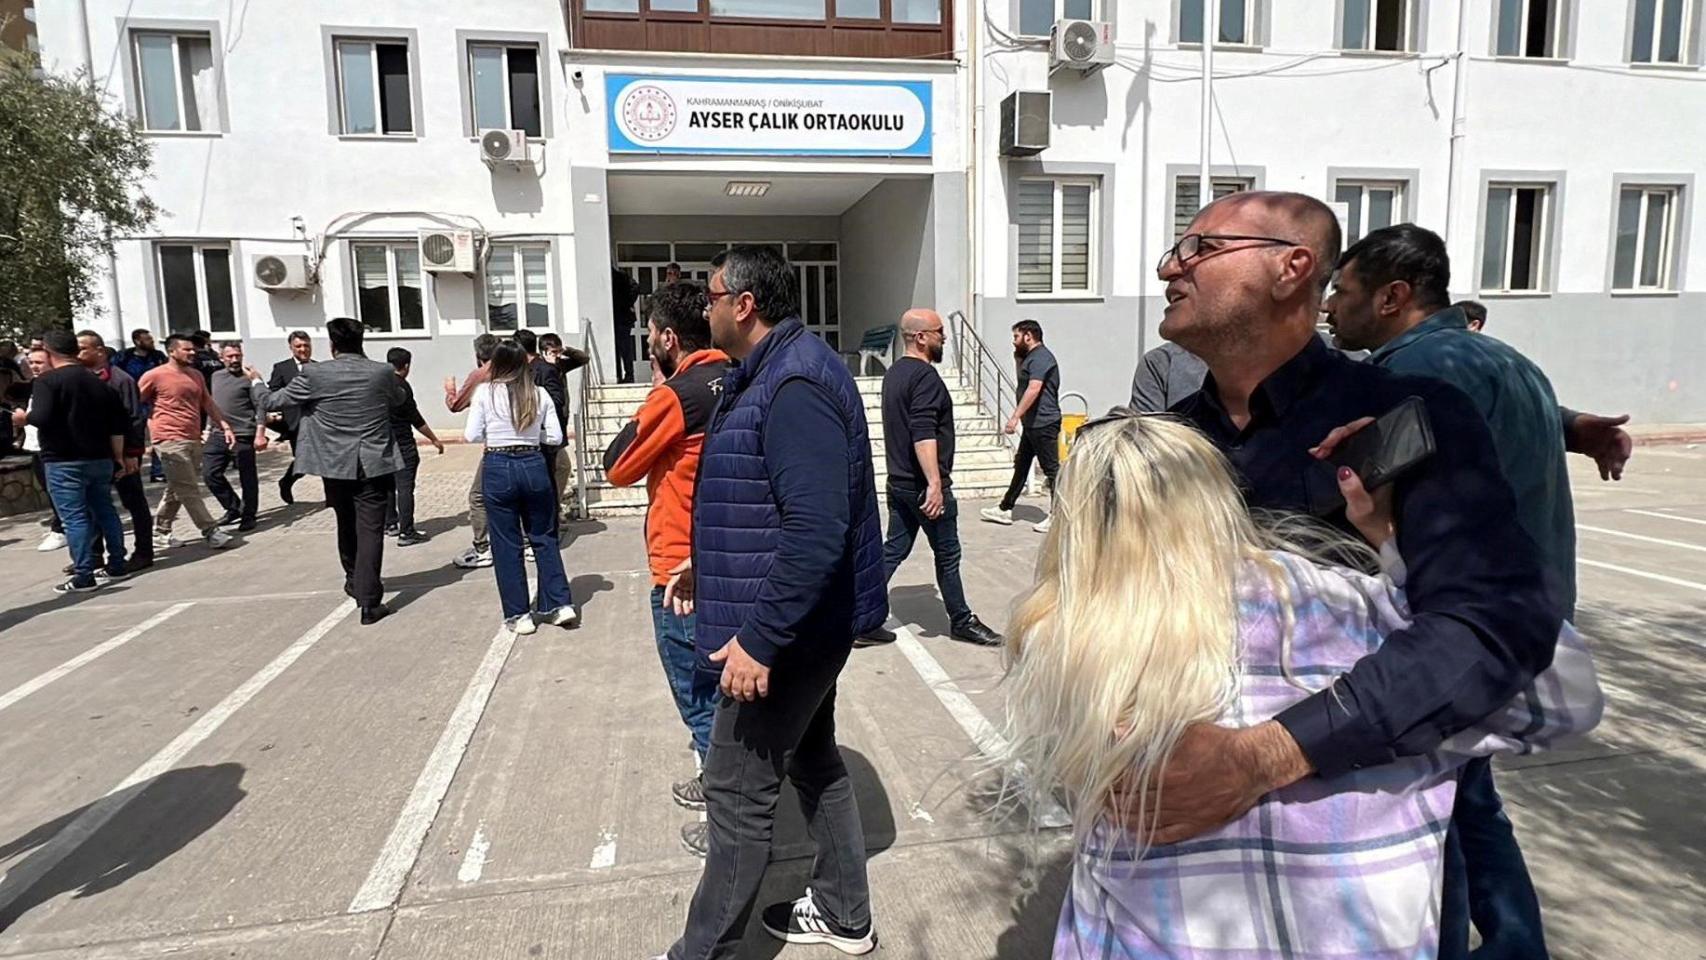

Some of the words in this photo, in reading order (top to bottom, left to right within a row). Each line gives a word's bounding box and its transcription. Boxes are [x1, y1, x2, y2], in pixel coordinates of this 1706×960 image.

[687, 97, 766, 109] KAHRAMANMARAŞ
[689, 111, 744, 128] AYSER
[748, 112, 798, 132] ÇALIK
[803, 113, 904, 131] ORTAOKULU
